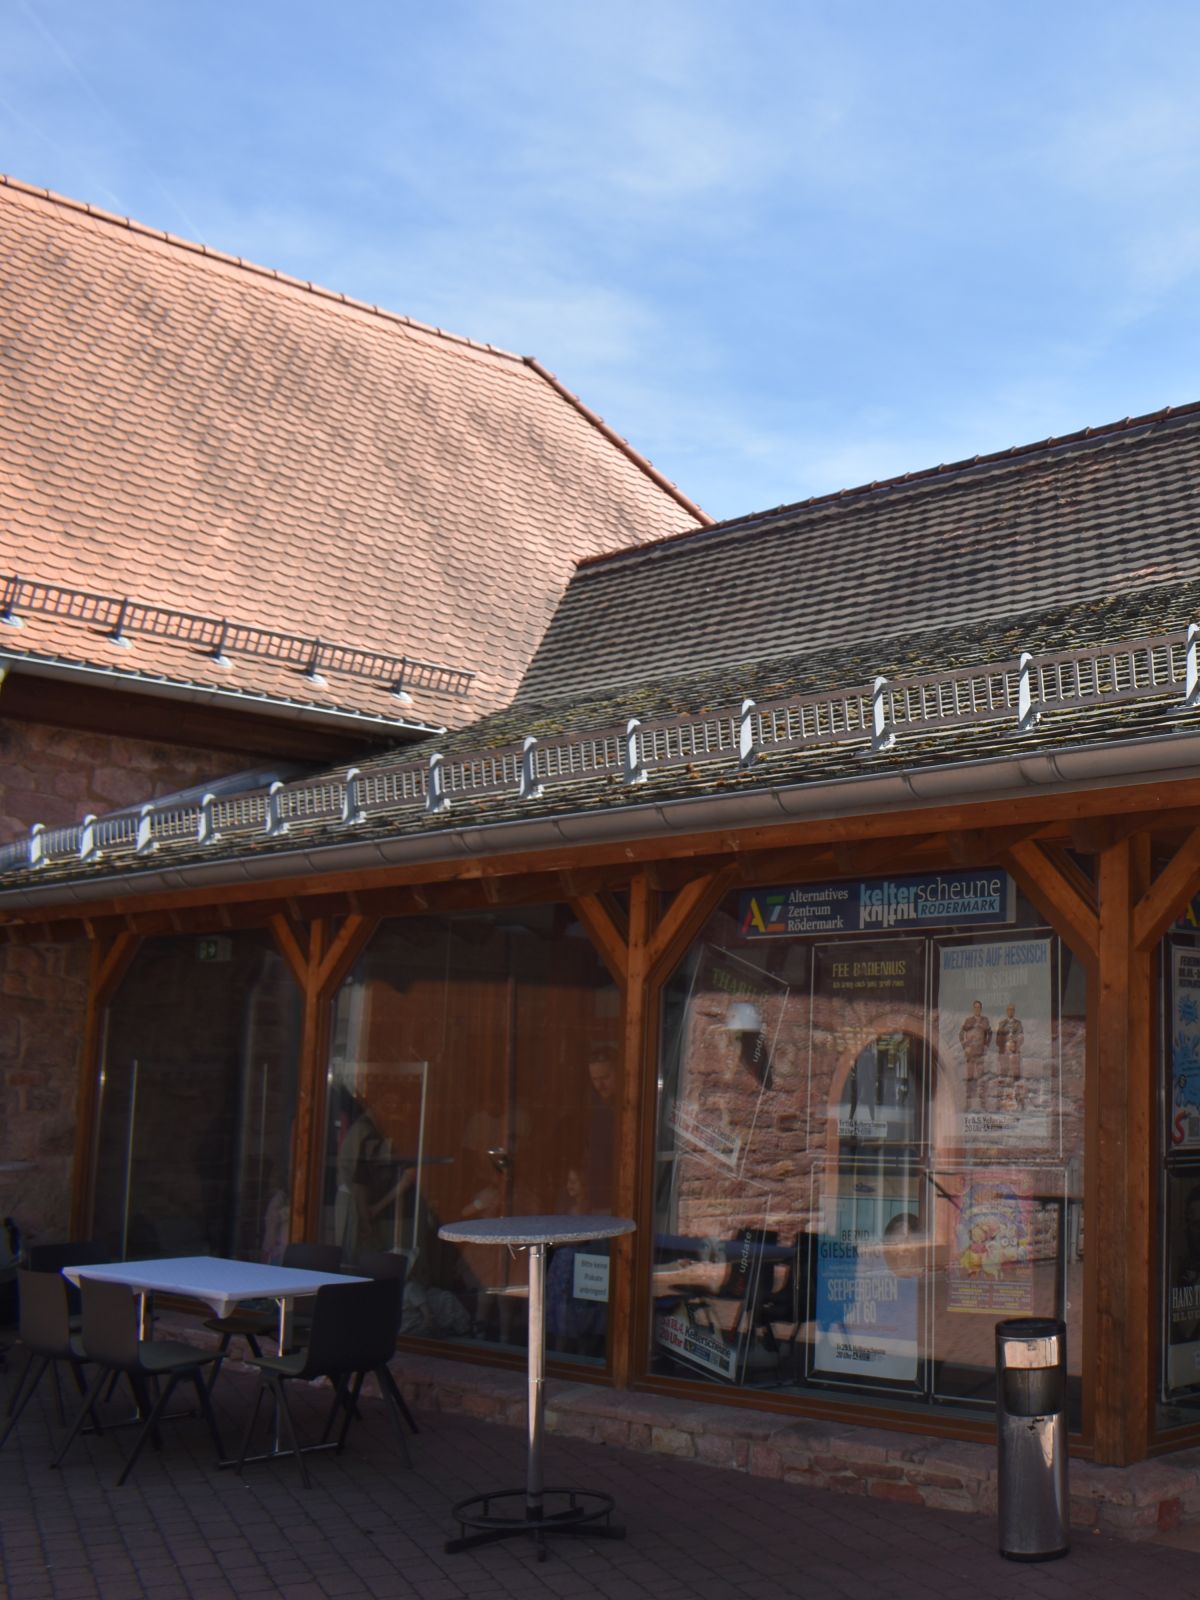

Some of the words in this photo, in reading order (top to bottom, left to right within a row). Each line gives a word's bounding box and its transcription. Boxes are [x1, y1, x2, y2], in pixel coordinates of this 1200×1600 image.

[788, 888, 849, 904] Alternatives
[787, 903, 831, 917] Zentrum
[787, 916, 845, 932] Rödermark
[943, 948, 984, 970] WELTHITS
[985, 946, 1002, 967] AUF
[1004, 943, 1047, 966] HESSISCH
[832, 962, 849, 978] FEE
[1172, 1286, 1193, 1309] HANS
[863, 1301, 877, 1323] 60
